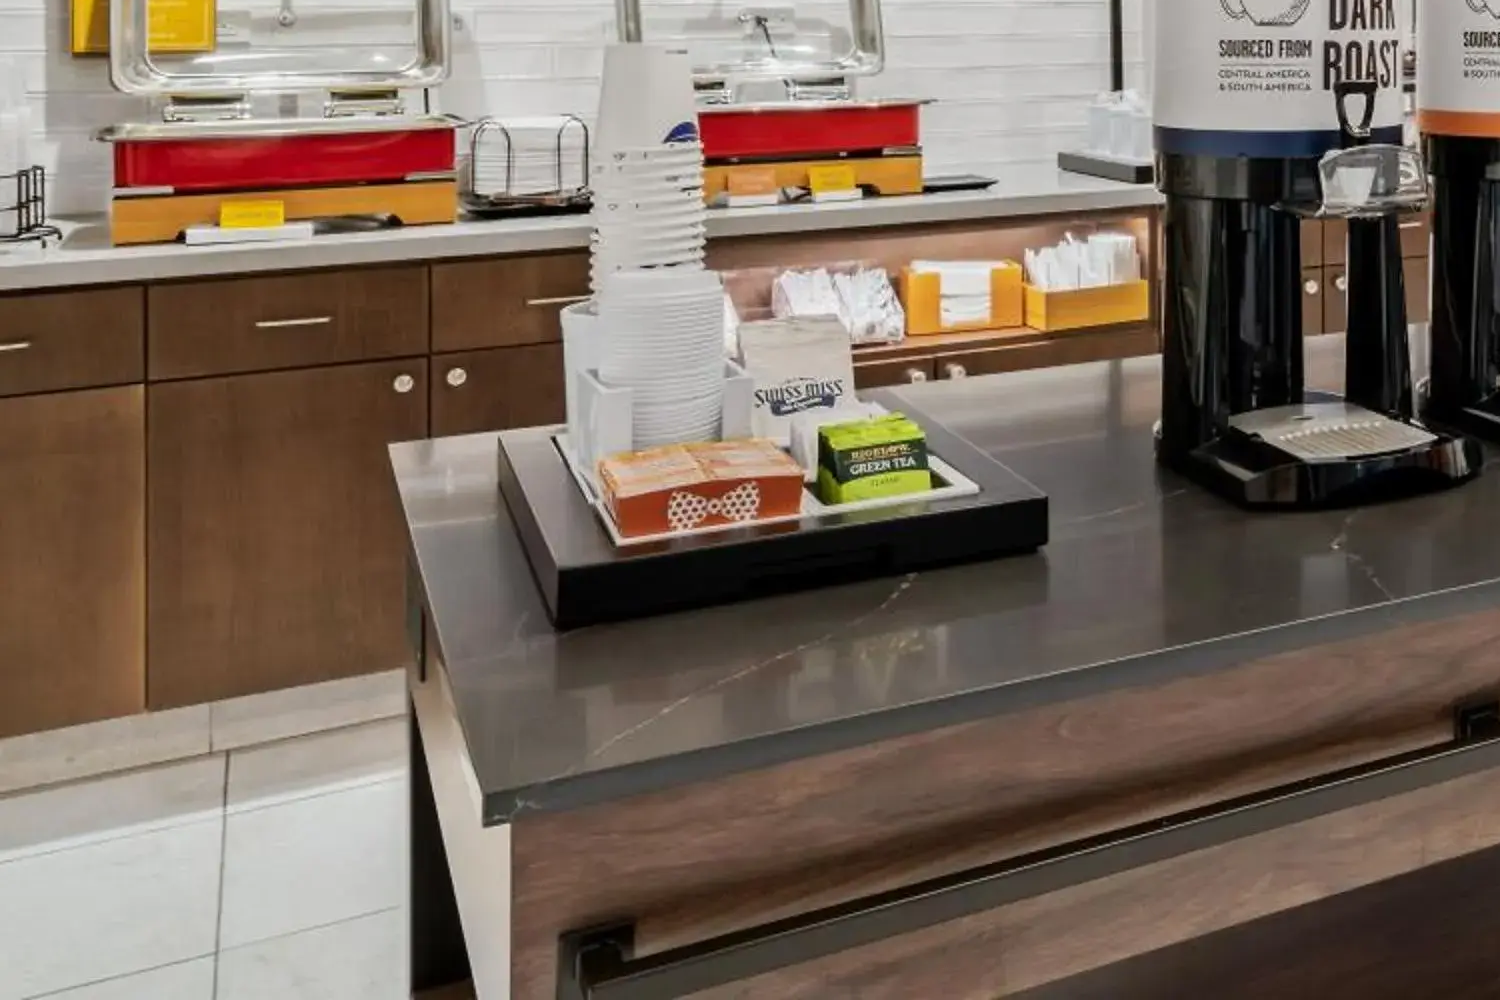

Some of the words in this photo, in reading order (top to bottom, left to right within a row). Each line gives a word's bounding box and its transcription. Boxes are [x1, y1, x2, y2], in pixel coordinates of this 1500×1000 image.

[1219, 40, 1273, 59] SOURCED
[1279, 40, 1313, 58] FROM
[1323, 39, 1399, 90] ROAST
[1463, 58, 1500, 67] CENTRAL
[1219, 69, 1262, 79] CENTRAL
[1265, 69, 1311, 79] AMERICA
[1471, 70, 1500, 79] SOUTH
[1227, 83, 1263, 92] SOUTH
[1265, 83, 1312, 92] AMERICA
[754, 386, 801, 409] SWISS
[804, 378, 843, 399] MISS
[849, 460, 891, 476] GREEN
[892, 455, 917, 469] TEA
